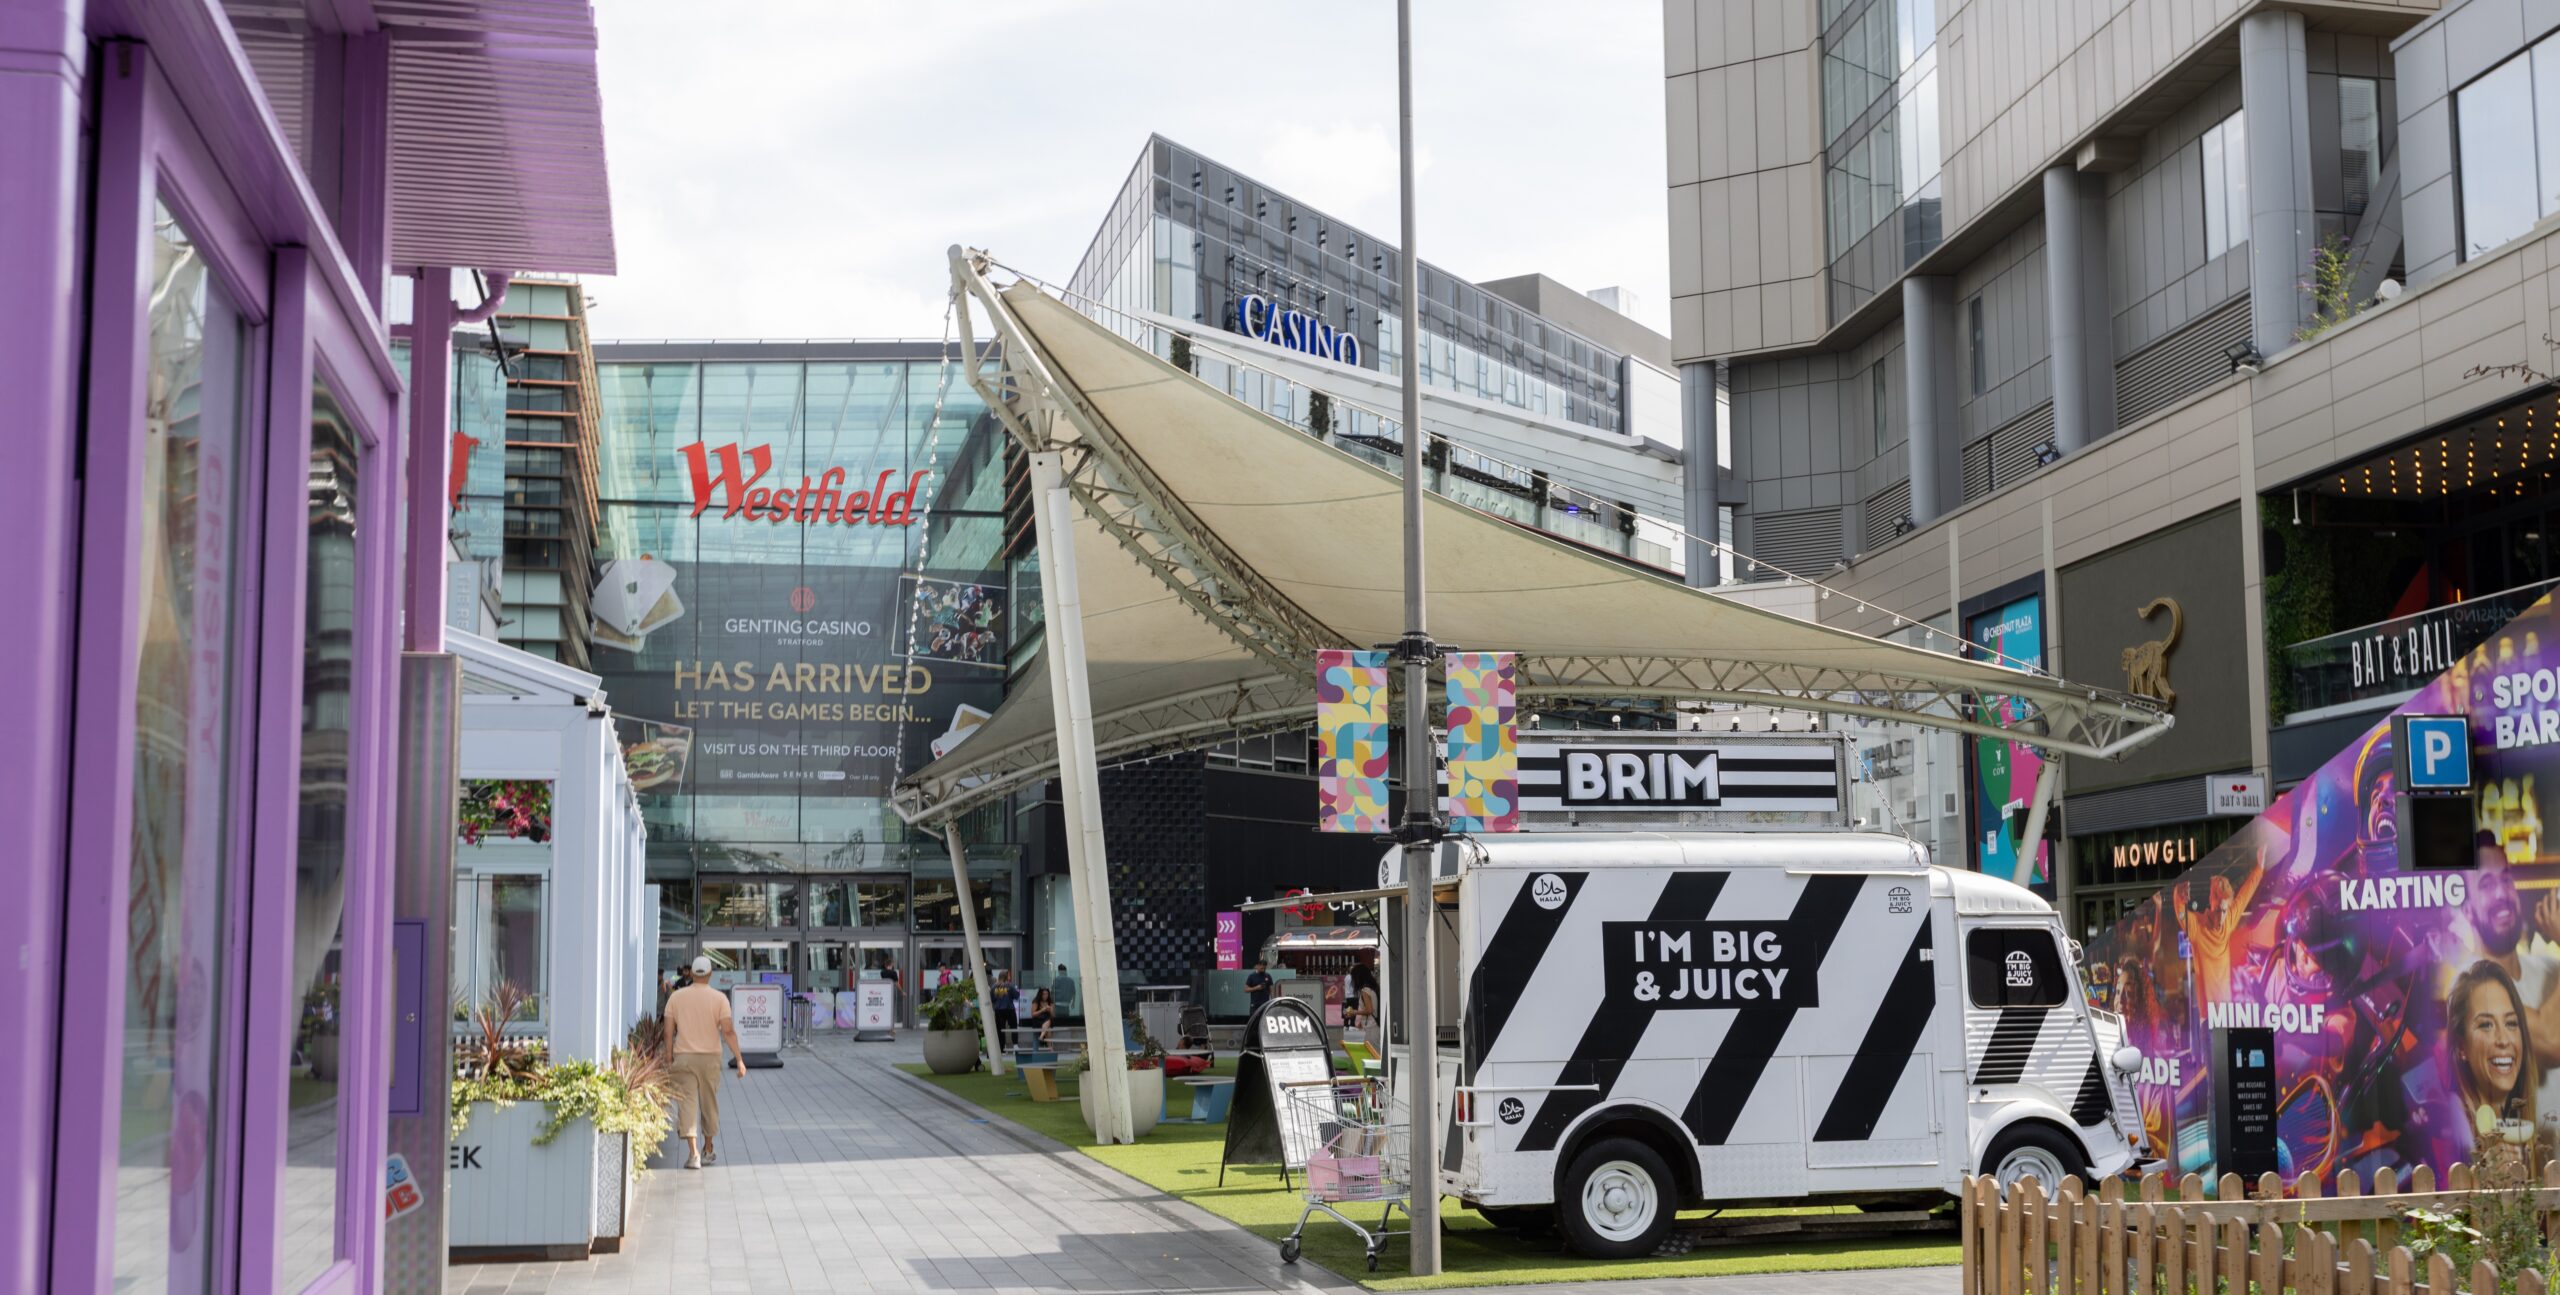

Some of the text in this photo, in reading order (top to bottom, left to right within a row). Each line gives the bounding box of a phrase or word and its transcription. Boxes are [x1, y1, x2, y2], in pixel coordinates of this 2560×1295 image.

[1239, 294, 1361, 367] CASINO
[676, 440, 929, 527] Westfield
[725, 618, 871, 636] GENTING CASINO
[777, 638, 824, 647] STRATFORD
[1989, 616, 2032, 638] CHESTNUT PLAZA
[2351, 618, 2455, 688] BAT & BALL
[674, 660, 932, 696] HAS ARRIVED
[2492, 666, 2560, 709] SPO
[674, 701, 932, 723] LET THE GAMES BEGIN...
[2495, 709, 2560, 750] BAR
[703, 743, 897, 758] VISIT US ON THE THIRD FLOOR
[2424, 730, 2452, 776] P
[1566, 752, 1720, 801] BRIM
[1992, 766, 2005, 777] COW
[2219, 795, 2235, 808] BAT
[2242, 795, 2260, 808] BALL
[2113, 837, 2195, 869] MOWGLI
[1534, 878, 1565, 896] حلال
[2340, 873, 2466, 911] KARTING
[1218, 953, 1237, 961] MAX
[1634, 930, 1782, 963] I'M BIG
[1633, 968, 1790, 1001] & JUICY
[1266, 1015, 1313, 1034] BRIM
[2207, 1002, 2325, 1034] MINI GOLF
[2134, 1056, 2181, 1087] ADE
[2246, 1081, 2266, 1089] REUSABLE
[1500, 1101, 1524, 1116] حلال
